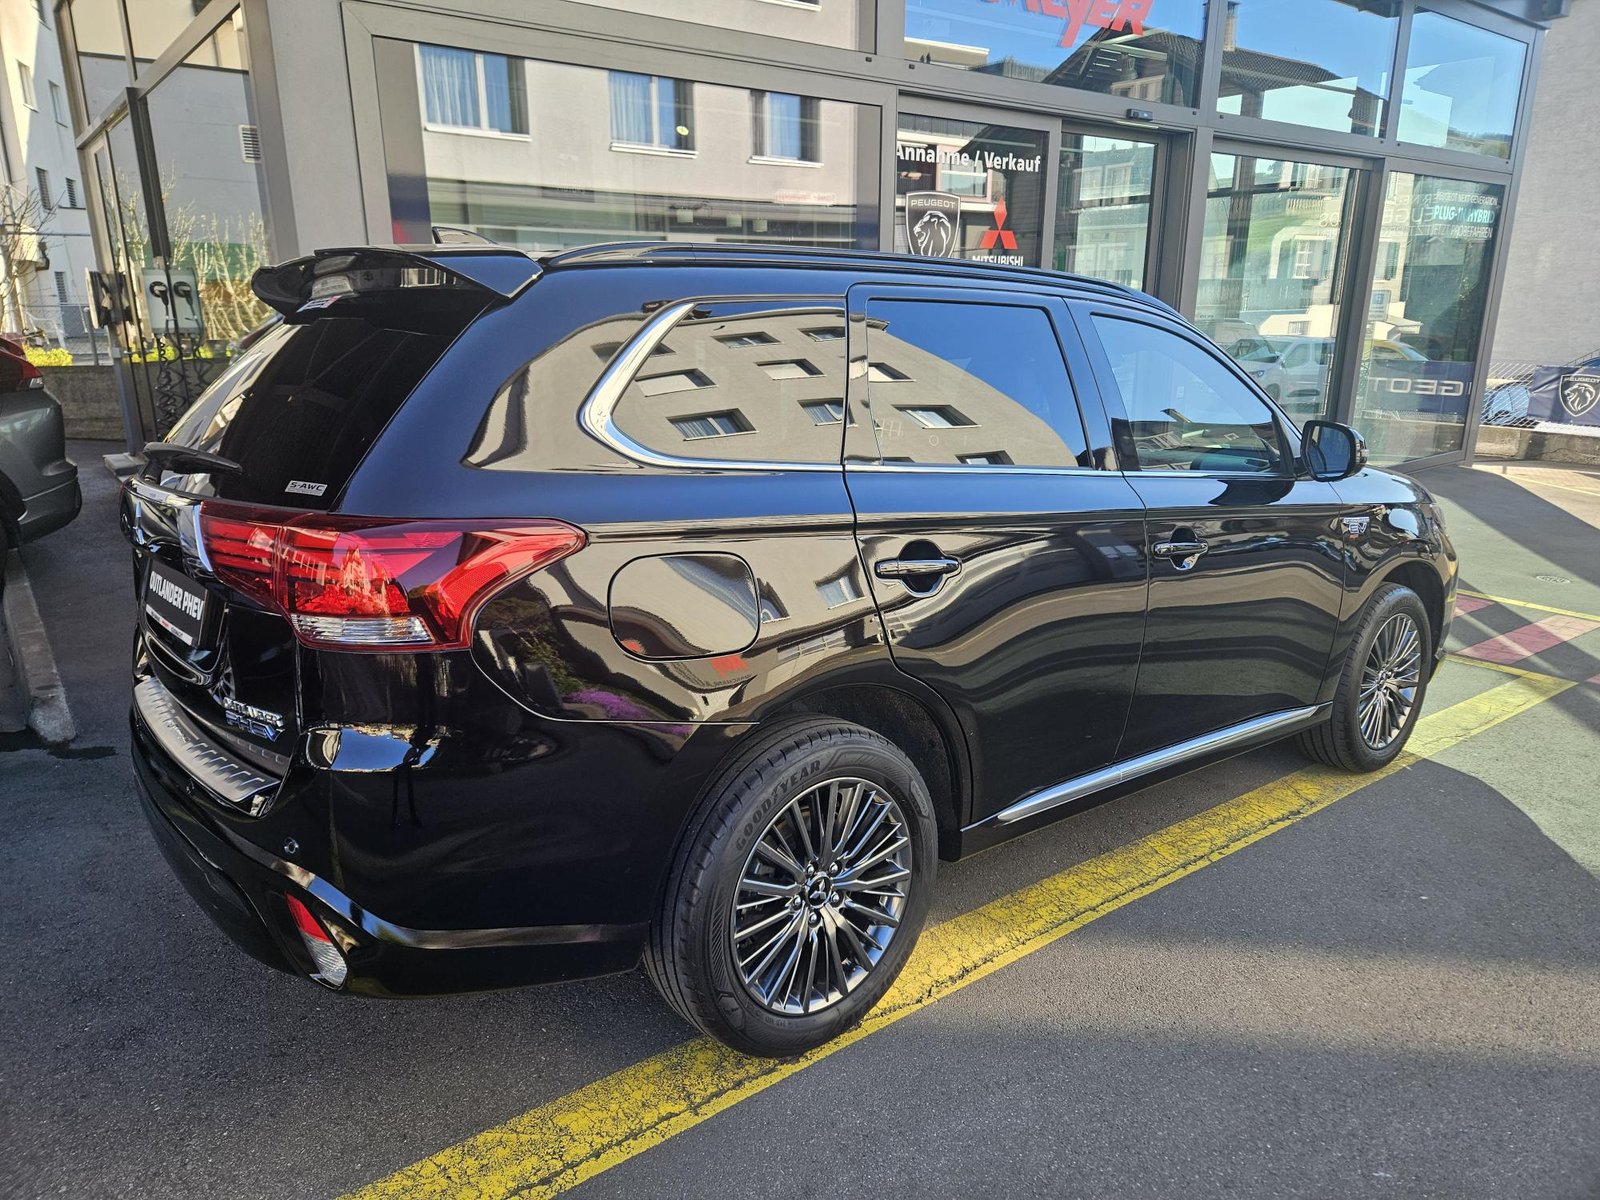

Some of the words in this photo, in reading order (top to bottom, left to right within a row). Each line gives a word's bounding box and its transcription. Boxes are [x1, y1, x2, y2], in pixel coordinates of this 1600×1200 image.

[896, 145, 970, 166] Annahme
[984, 152, 1041, 172] Verkauf
[911, 199, 956, 208] PEUGEOT
[290, 482, 325, 491] S-AWC
[149, 571, 183, 609] OUTLANDER
[182, 591, 204, 620] PHEV
[736, 760, 821, 850] GOODYEAR
